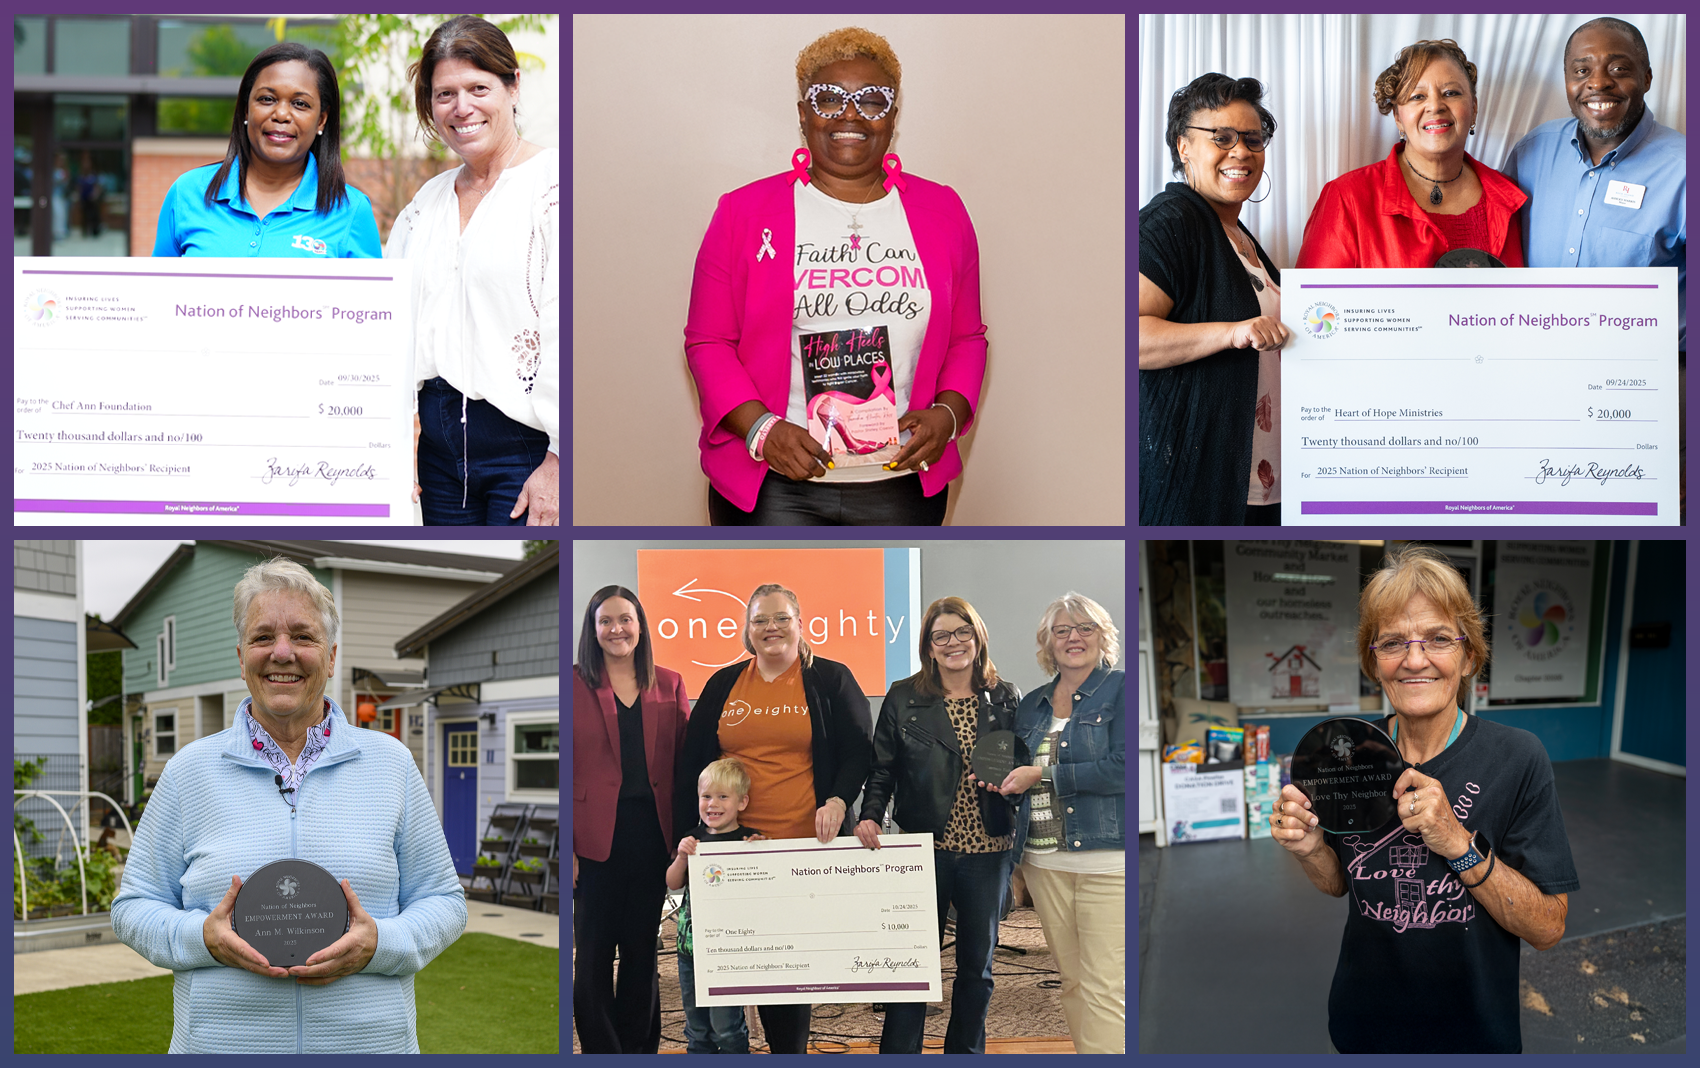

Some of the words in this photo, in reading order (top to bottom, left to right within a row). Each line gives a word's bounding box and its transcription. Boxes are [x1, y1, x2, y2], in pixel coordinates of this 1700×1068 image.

[796, 243, 856, 265] Faith
[866, 241, 916, 263] Can
[794, 293, 838, 320] All
[846, 291, 924, 320] Odds
[175, 304, 225, 318] Nation
[228, 304, 245, 318] of
[332, 306, 392, 324] Program
[1448, 314, 1497, 327] Nation
[1500, 313, 1515, 327] of
[1599, 314, 1658, 330] Program
[804, 332, 841, 365] High
[846, 328, 886, 353] Heels
[814, 356, 840, 370] LOW
[844, 351, 886, 366] PLACES
[338, 374, 380, 382] 09/30/2025
[1606, 378, 1647, 387] 09/24/2025
[16, 398, 28, 406] Pay
[52, 400, 75, 410] Chef
[76, 401, 97, 410] Ann
[99, 401, 152, 411] Foundation
[318, 402, 325, 414] $
[328, 405, 364, 416] 20,000
[1300, 406, 1312, 414] Pay
[1334, 408, 1359, 418] Heart
[1362, 408, 1372, 418] of
[1373, 408, 1398, 420] Hope
[1399, 408, 1444, 418] Ministries
[1587, 406, 1594, 418] $
[1596, 409, 1632, 420] 20,000
[16, 430, 54, 444] Twenty
[57, 430, 106, 442] thousand
[107, 431, 143, 442] dollars
[144, 432, 164, 442] and
[167, 432, 203, 443] no/100
[1301, 436, 1338, 448] Twenty
[1340, 436, 1386, 446] thousand
[1388, 436, 1422, 446] dollars
[1424, 436, 1442, 446] and
[1444, 436, 1479, 446] no/100
[32, 462, 53, 472] 2025
[54, 462, 86, 472] Nation
[87, 462, 98, 472] of
[149, 464, 191, 476] Recipient
[314, 460, 378, 487] Reynolds
[1317, 466, 1338, 475] 2025
[1339, 466, 1368, 475] Nation
[1370, 466, 1381, 475] of
[1429, 466, 1468, 477] Recipient
[1585, 462, 1646, 486] Reynolds
[658, 617, 738, 640] one
[721, 706, 745, 718] one
[754, 704, 810, 716] eighty
[1303, 775, 1360, 787] EMPOWERMENT
[1362, 774, 1392, 782] AWARD
[1311, 794, 1330, 802] Love
[1333, 792, 1348, 800] Thy
[1351, 790, 1388, 799] Neighbor
[791, 867, 822, 876] Nation
[823, 866, 832, 874] of
[885, 864, 924, 874] Program
[1354, 866, 1416, 880] Love
[1426, 872, 1466, 900] thy
[244, 913, 302, 922] EMPOWERMENT
[304, 912, 334, 920] AWARD
[1361, 900, 1472, 934] Neighbor
[254, 929, 272, 937] Ann
[286, 927, 325, 935] Wilkinson
[738, 928, 756, 936] Eighty
[881, 922, 887, 930] $
[888, 923, 910, 931] 10,000
